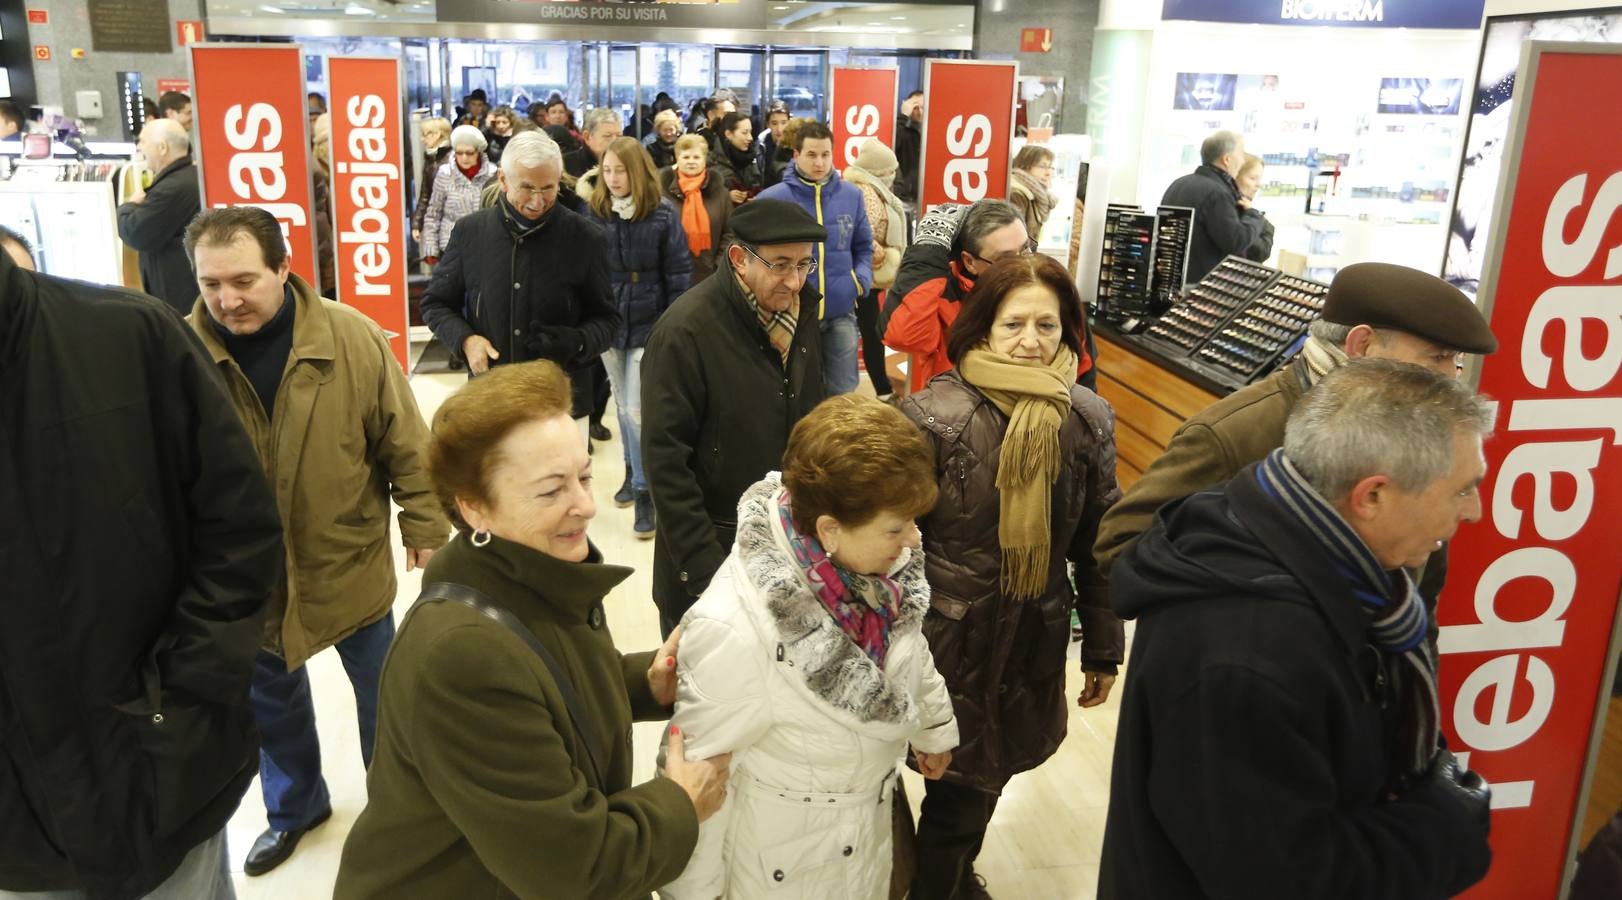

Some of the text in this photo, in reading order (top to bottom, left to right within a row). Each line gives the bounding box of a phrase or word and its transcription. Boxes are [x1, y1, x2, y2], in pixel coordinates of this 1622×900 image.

[541, 6, 668, 21] GRACIAS POR SU VISITA
[337, 94, 399, 296] rebajas
